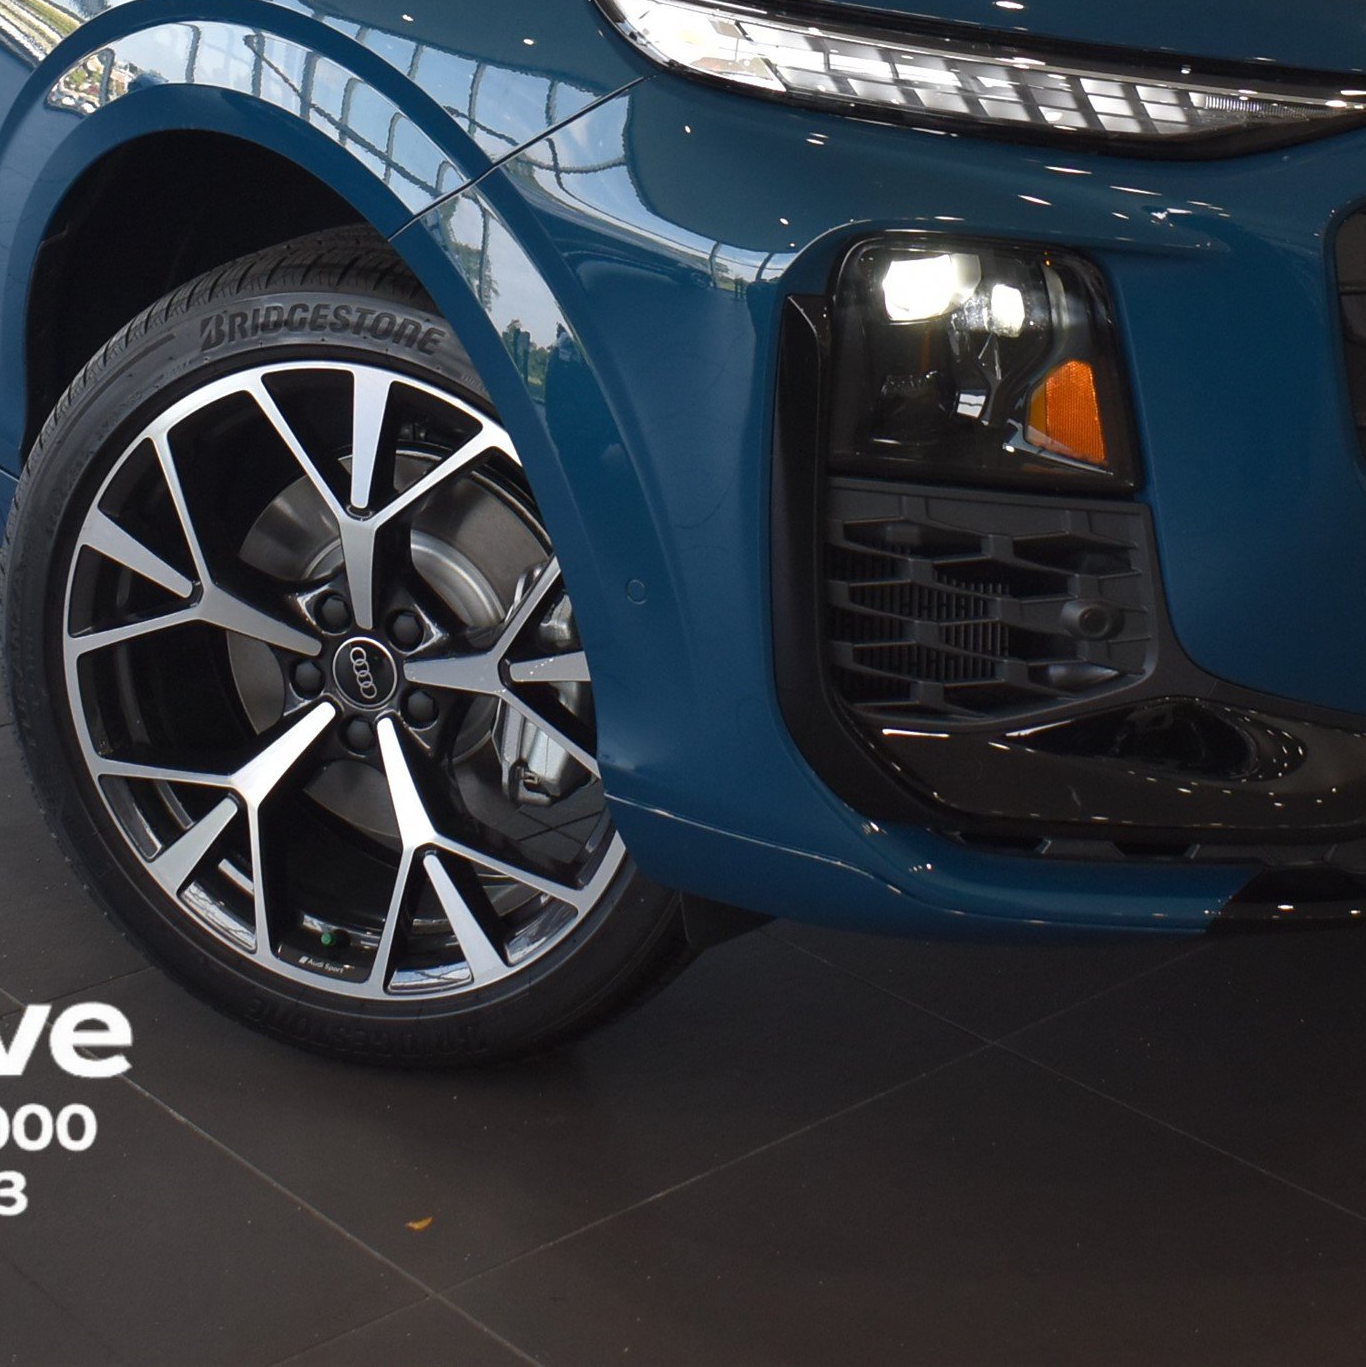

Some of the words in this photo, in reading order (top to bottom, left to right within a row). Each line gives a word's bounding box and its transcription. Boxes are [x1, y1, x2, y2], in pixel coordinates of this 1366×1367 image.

[199, 303, 447, 353] BRIDGESTONE
[307, 958, 324, 968] Audi
[324, 963, 344, 974] Sport
